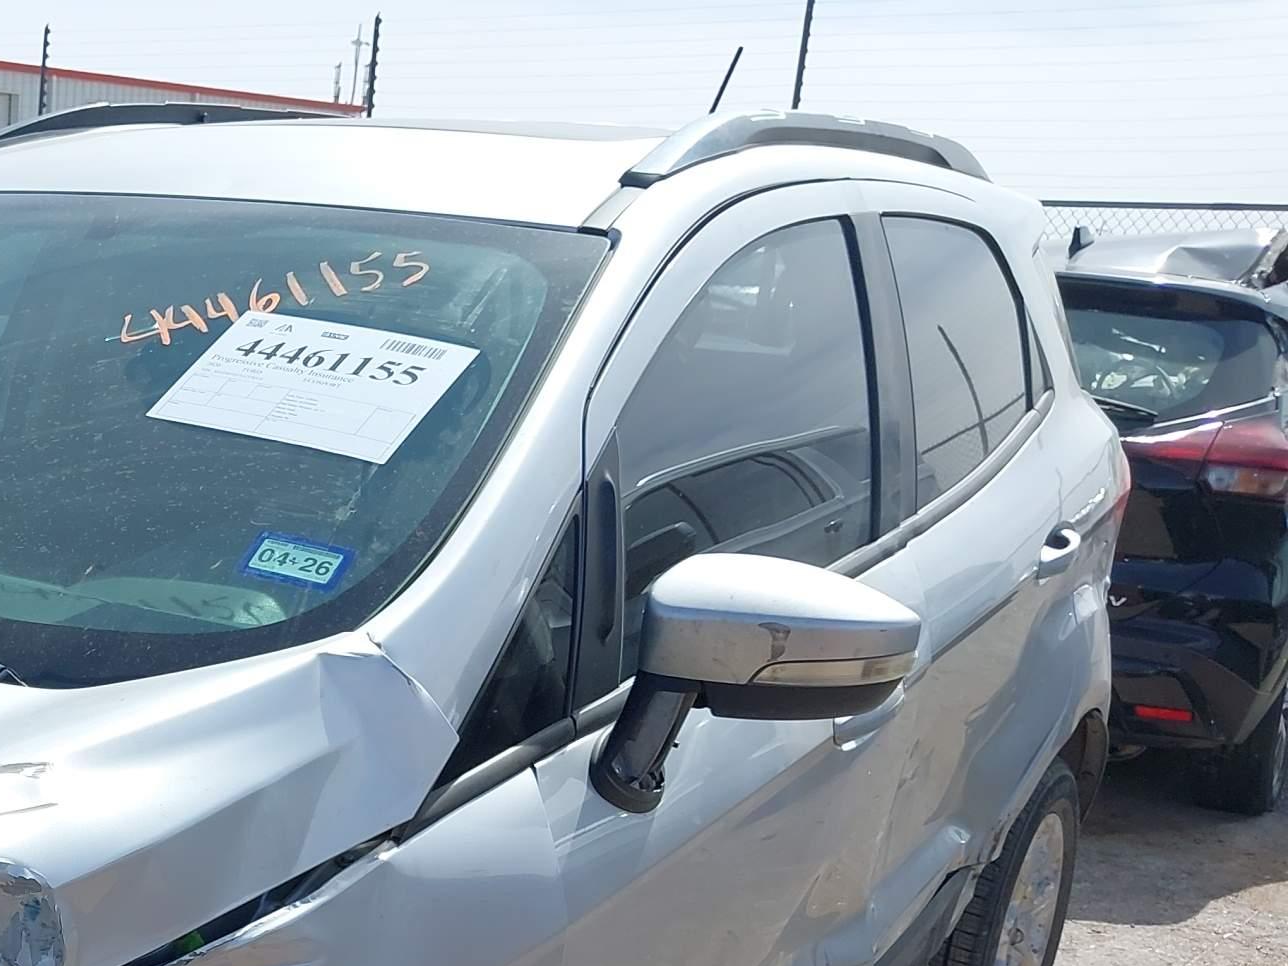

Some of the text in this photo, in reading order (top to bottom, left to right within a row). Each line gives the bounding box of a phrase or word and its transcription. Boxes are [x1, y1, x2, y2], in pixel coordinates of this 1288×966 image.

[120, 251, 430, 345] 44461155
[211, 354, 265, 369] Progressive
[265, 361, 305, 376] Casualty
[307, 368, 355, 384] Insurance
[234, 338, 428, 386] 44461155
[257, 548, 289, 567] 04
[298, 557, 334, 576] 26
